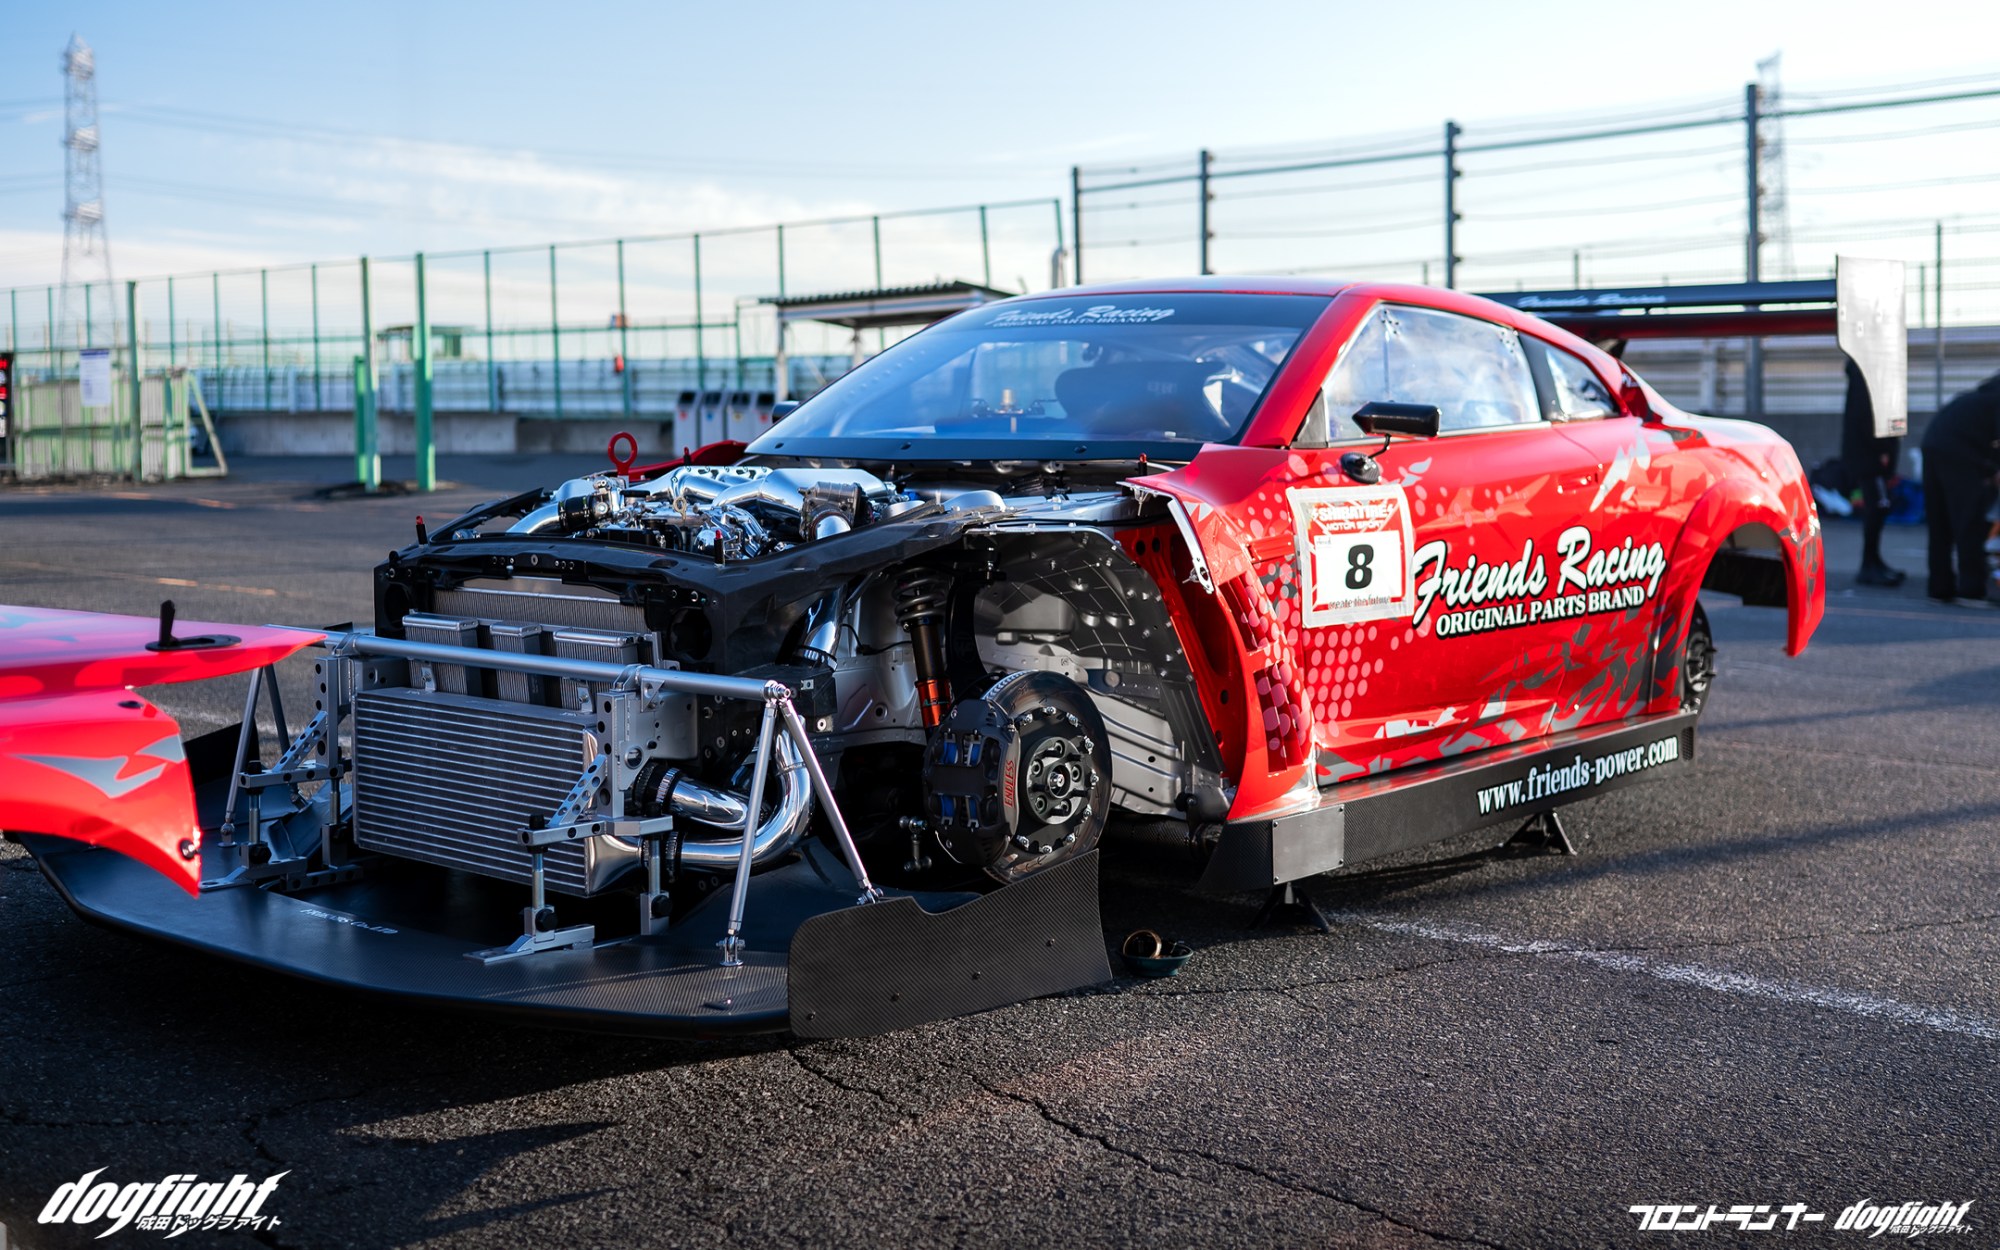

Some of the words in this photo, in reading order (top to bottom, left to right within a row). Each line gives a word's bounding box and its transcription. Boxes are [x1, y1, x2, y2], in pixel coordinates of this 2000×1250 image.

[984, 307, 1074, 326] Friends
[1078, 305, 1175, 321] Racing
[1345, 544, 1374, 589] 8
[1412, 538, 1548, 625] Friends
[1557, 526, 1666, 598] Racing
[1436, 604, 1528, 636] ORIGINAL
[1528, 594, 1586, 621] PARTS
[1588, 586, 1645, 610] BRAND
[1004, 760, 1015, 807] ENDLESS
[1477, 736, 1678, 814] www.friends-power.com
